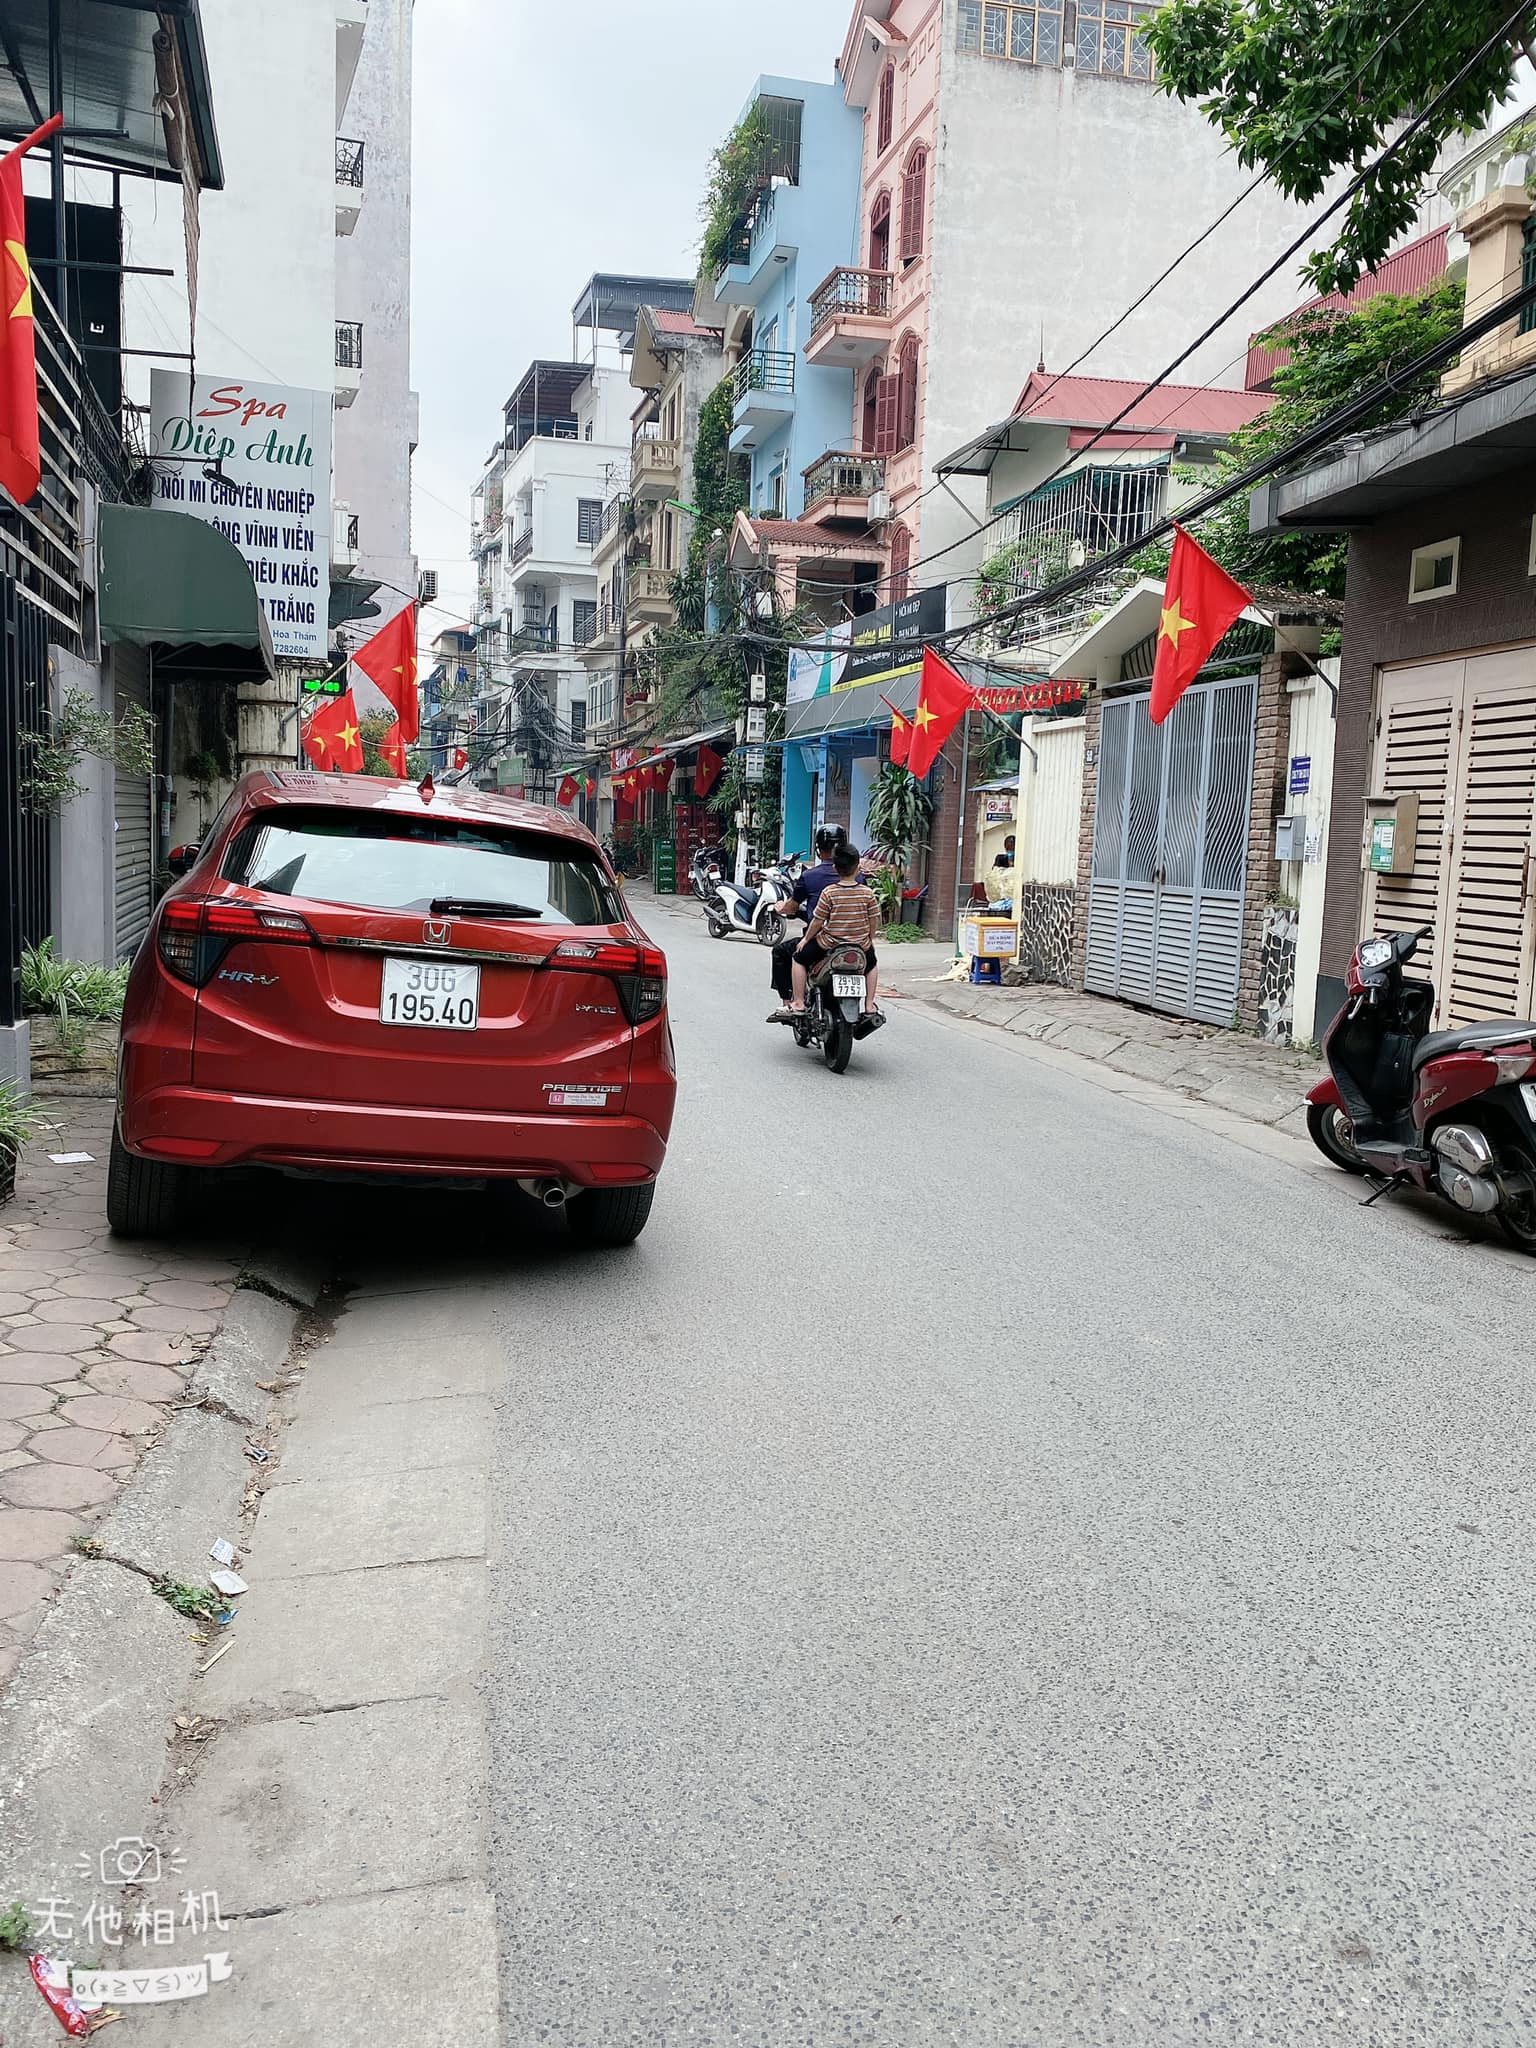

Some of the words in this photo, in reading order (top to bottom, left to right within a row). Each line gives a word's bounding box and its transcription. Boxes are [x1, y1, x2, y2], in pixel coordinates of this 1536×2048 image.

[196, 386, 287, 426] Spa
[246, 429, 314, 467] Anh
[161, 472, 185, 500] NỐI
[189, 479, 206, 504] MI
[267, 488, 315, 518] NGHIỆP
[205, 516, 241, 545] ÔNG
[246, 520, 278, 548] VĨNH
[283, 521, 314, 552] VIỄN
[282, 558, 319, 588] KHẮC
[270, 593, 315, 625] TRẮNG
[273, 629, 290, 640] Hoa
[218, 969, 280, 985] HR-V
[407, 963, 457, 993] 30G
[838, 986, 861, 996] 7757
[388, 992, 474, 1025] 195.40
[541, 1083, 623, 1093] PRESTIGE
